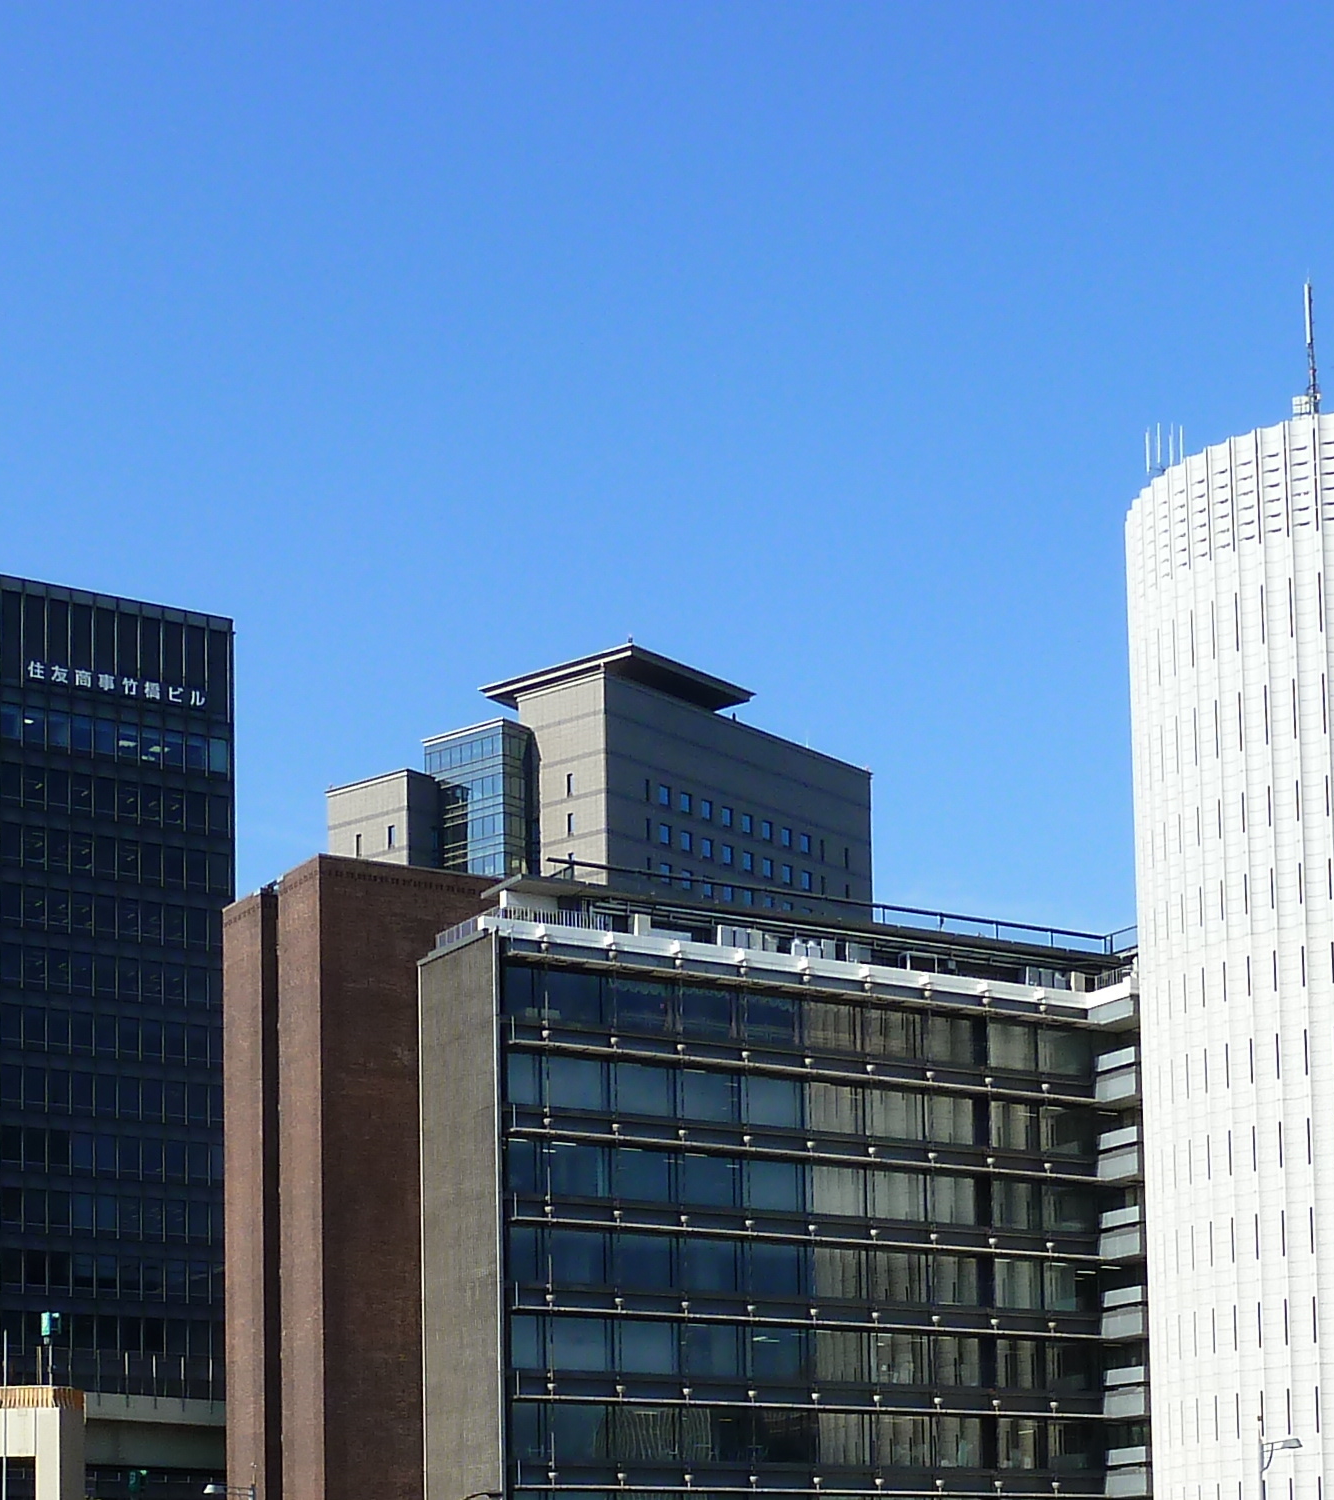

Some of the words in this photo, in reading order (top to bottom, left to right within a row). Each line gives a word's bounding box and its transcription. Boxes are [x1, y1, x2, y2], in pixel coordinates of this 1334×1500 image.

[27, 660, 206, 706] 住友商事竹橋ビル
